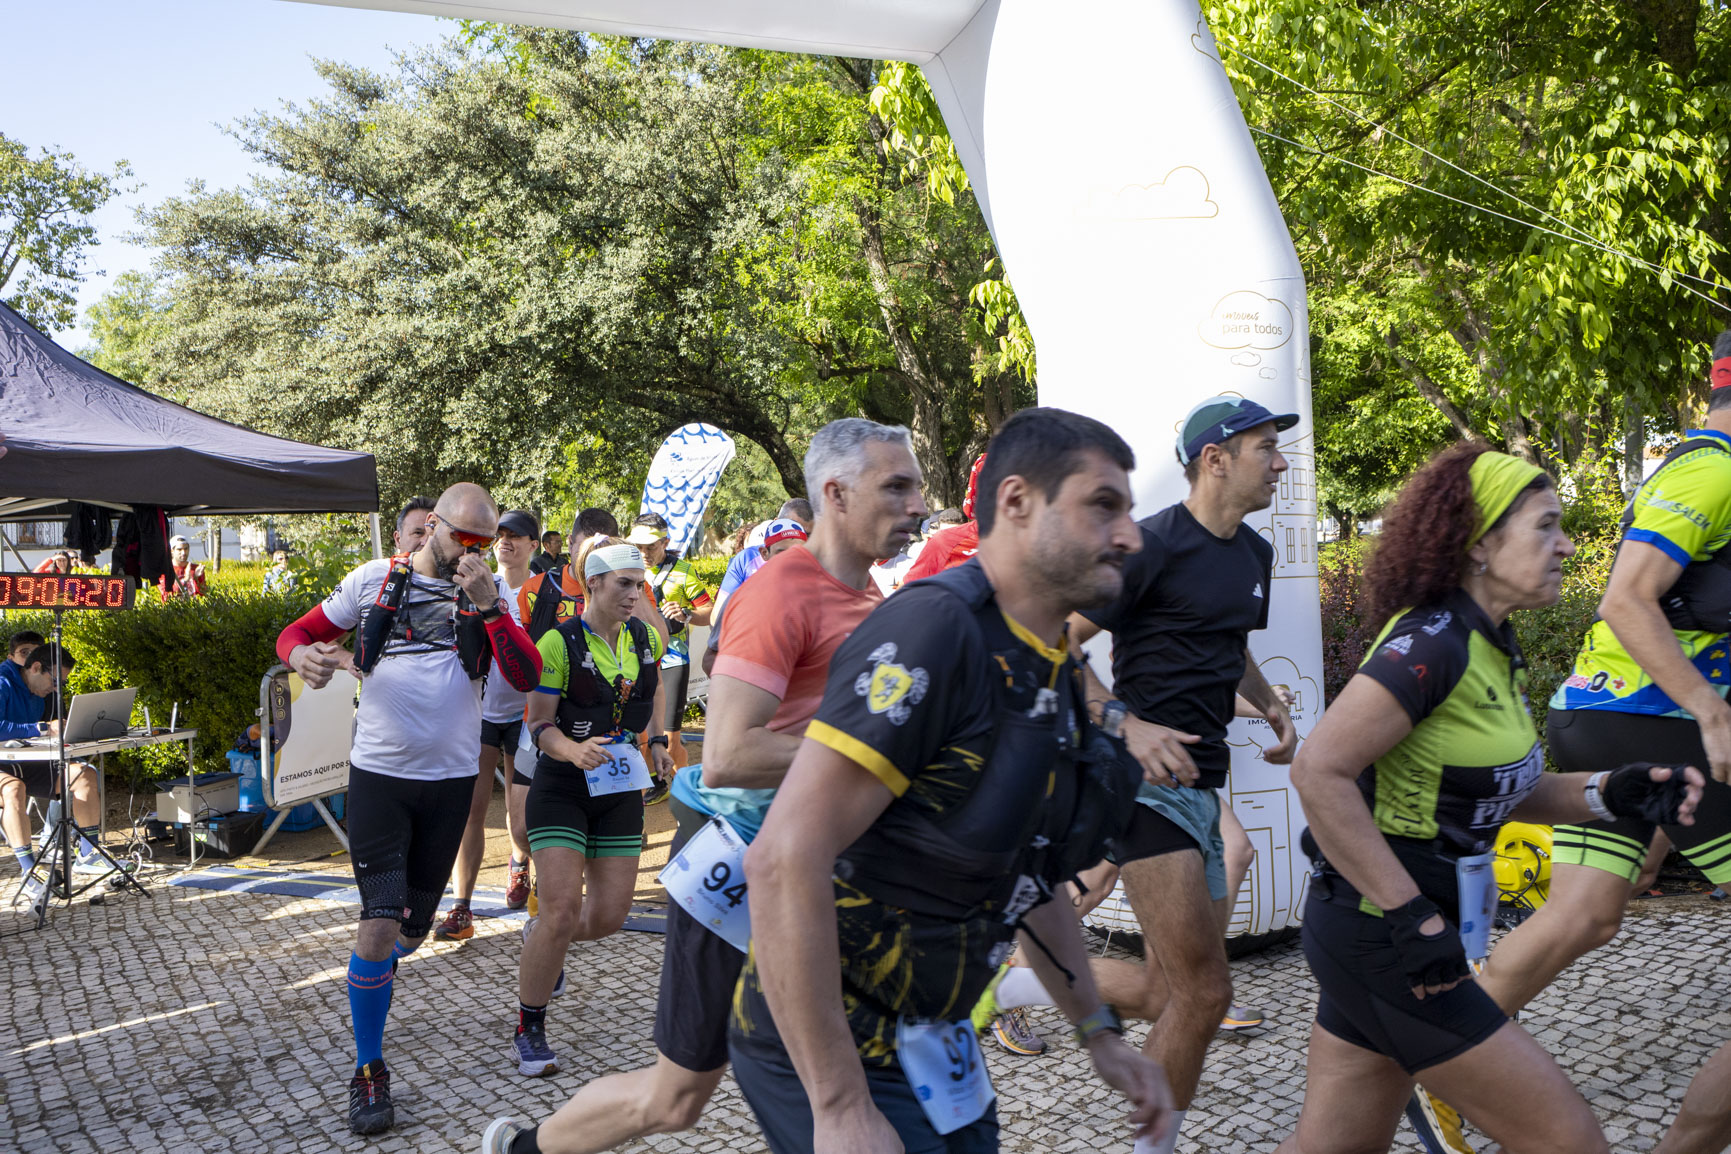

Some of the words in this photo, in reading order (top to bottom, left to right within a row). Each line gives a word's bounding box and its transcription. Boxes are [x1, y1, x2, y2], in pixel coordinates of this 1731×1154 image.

[1222, 324, 1250, 335] para
[1254, 323, 1283, 335] todos
[280, 769, 313, 784] ESTAMOS
[314, 764, 331, 775] AQUI
[331, 761, 345, 771] POR
[608, 757, 631, 777] 35
[703, 861, 748, 908] 94
[943, 1026, 976, 1082] 92
